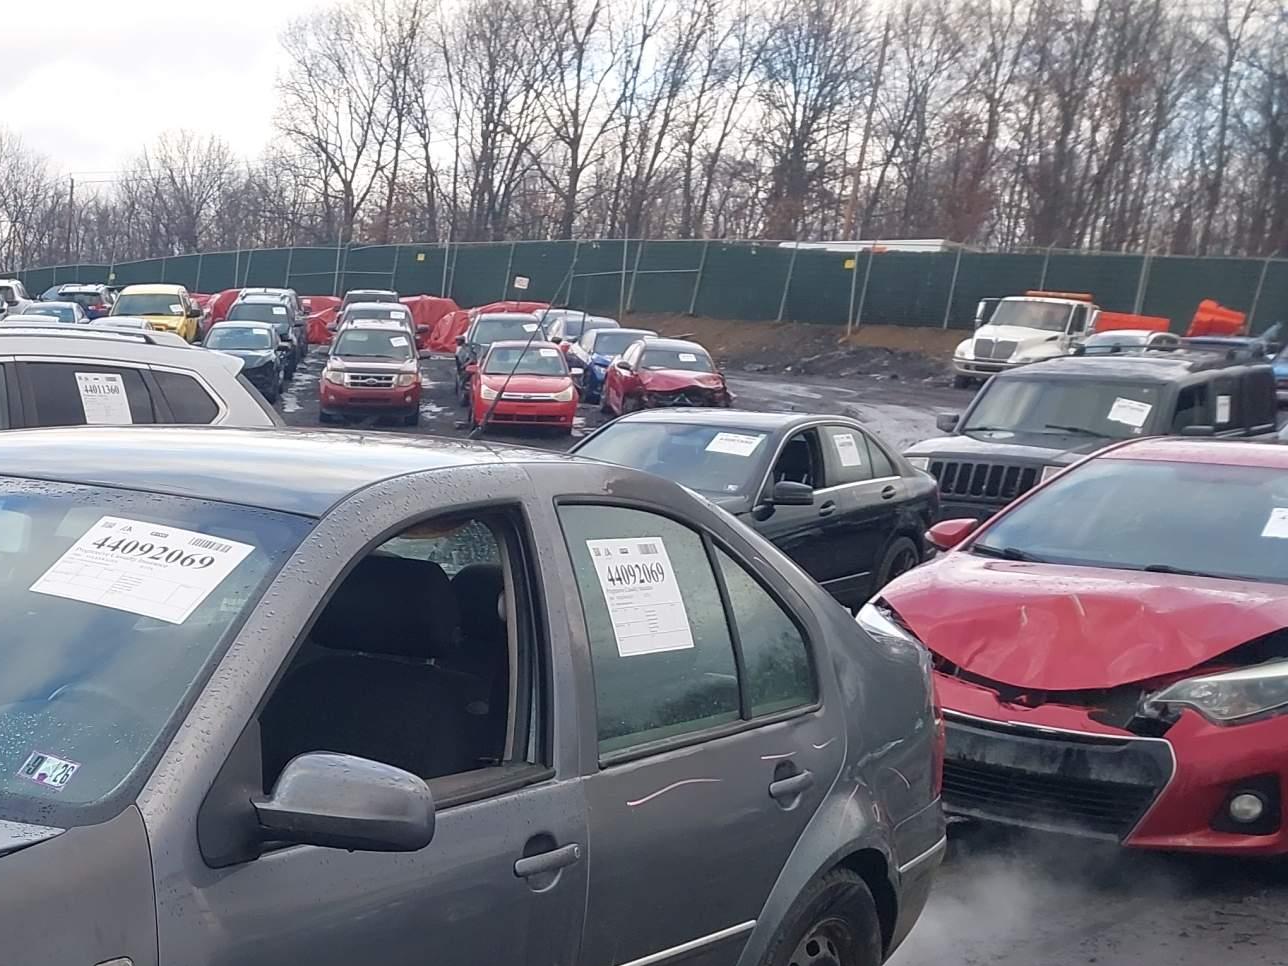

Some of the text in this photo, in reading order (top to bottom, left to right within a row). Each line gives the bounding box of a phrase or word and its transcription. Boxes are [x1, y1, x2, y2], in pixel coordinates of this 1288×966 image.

[92, 536, 215, 569] 44092069
[607, 562, 665, 586] 44092069
[52, 763, 75, 784] 26
